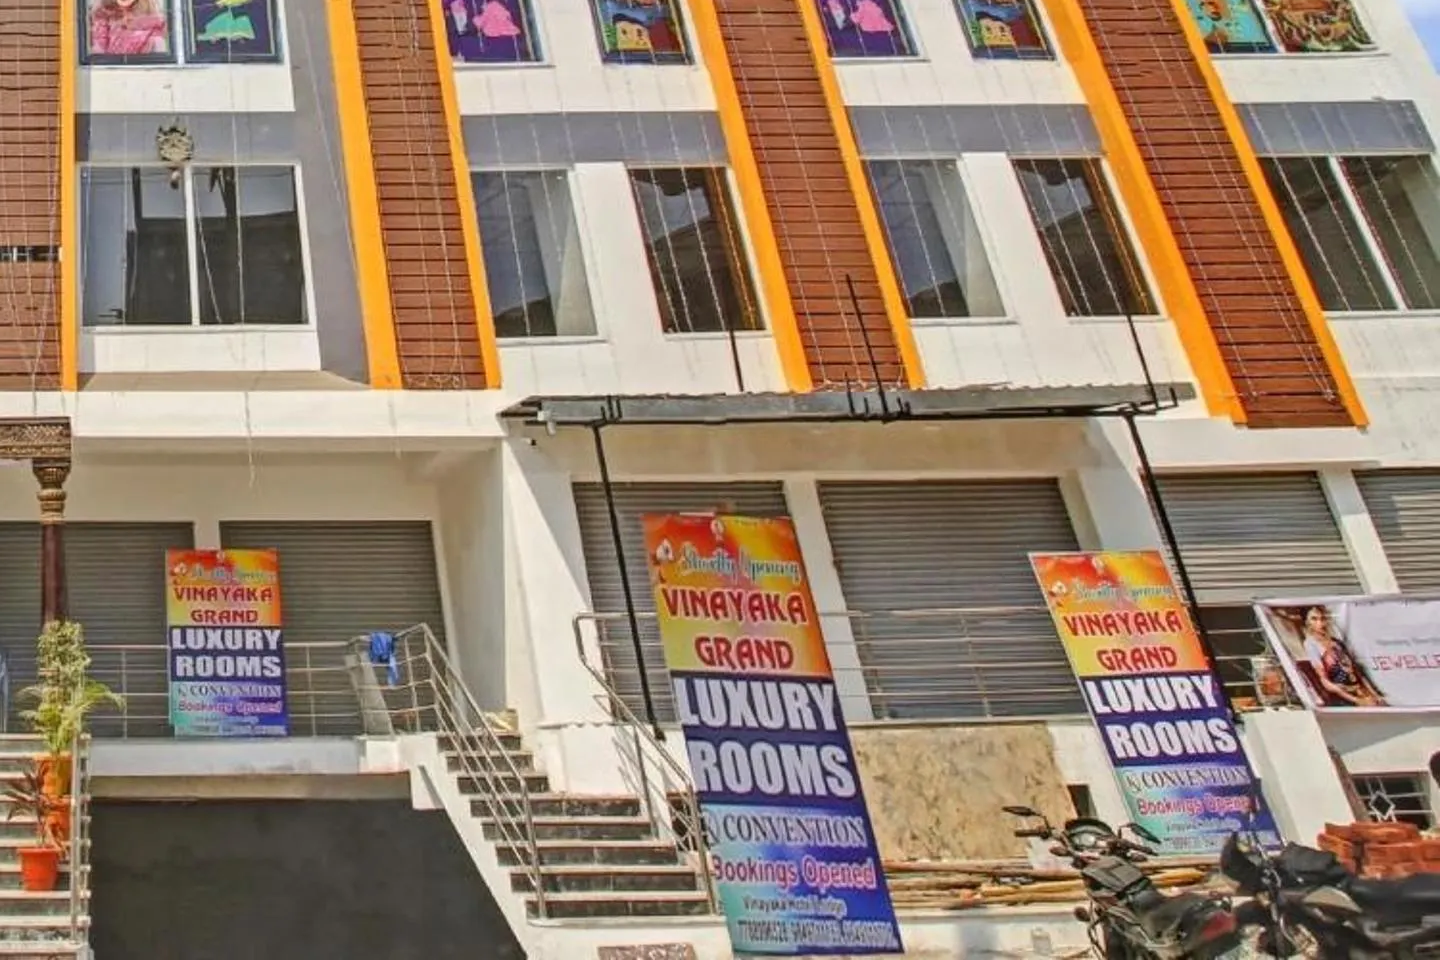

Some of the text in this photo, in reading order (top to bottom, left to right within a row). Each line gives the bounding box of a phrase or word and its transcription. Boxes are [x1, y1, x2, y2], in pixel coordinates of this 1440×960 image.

[174, 587, 273, 602] VINAYAKA
[662, 588, 808, 624] VINAYAKA
[190, 609, 259, 624] GRAND
[1063, 610, 1183, 637] VINAYAKA
[171, 628, 281, 650] LUXURY
[694, 636, 794, 670] GRAND
[176, 655, 281, 677] ROOMS
[1096, 646, 1178, 672] GRAND
[673, 678, 838, 731] LUXURY
[1084, 675, 1218, 714] LUXURY
[1105, 718, 1238, 759] ROOMS
[686, 740, 857, 798] ROOMS
[1141, 767, 1251, 789] CONVENTION
[1137, 796, 1204, 816] Bookings
[723, 813, 868, 846] CONVENTION
[712, 855, 877, 891] Bookings Opened
